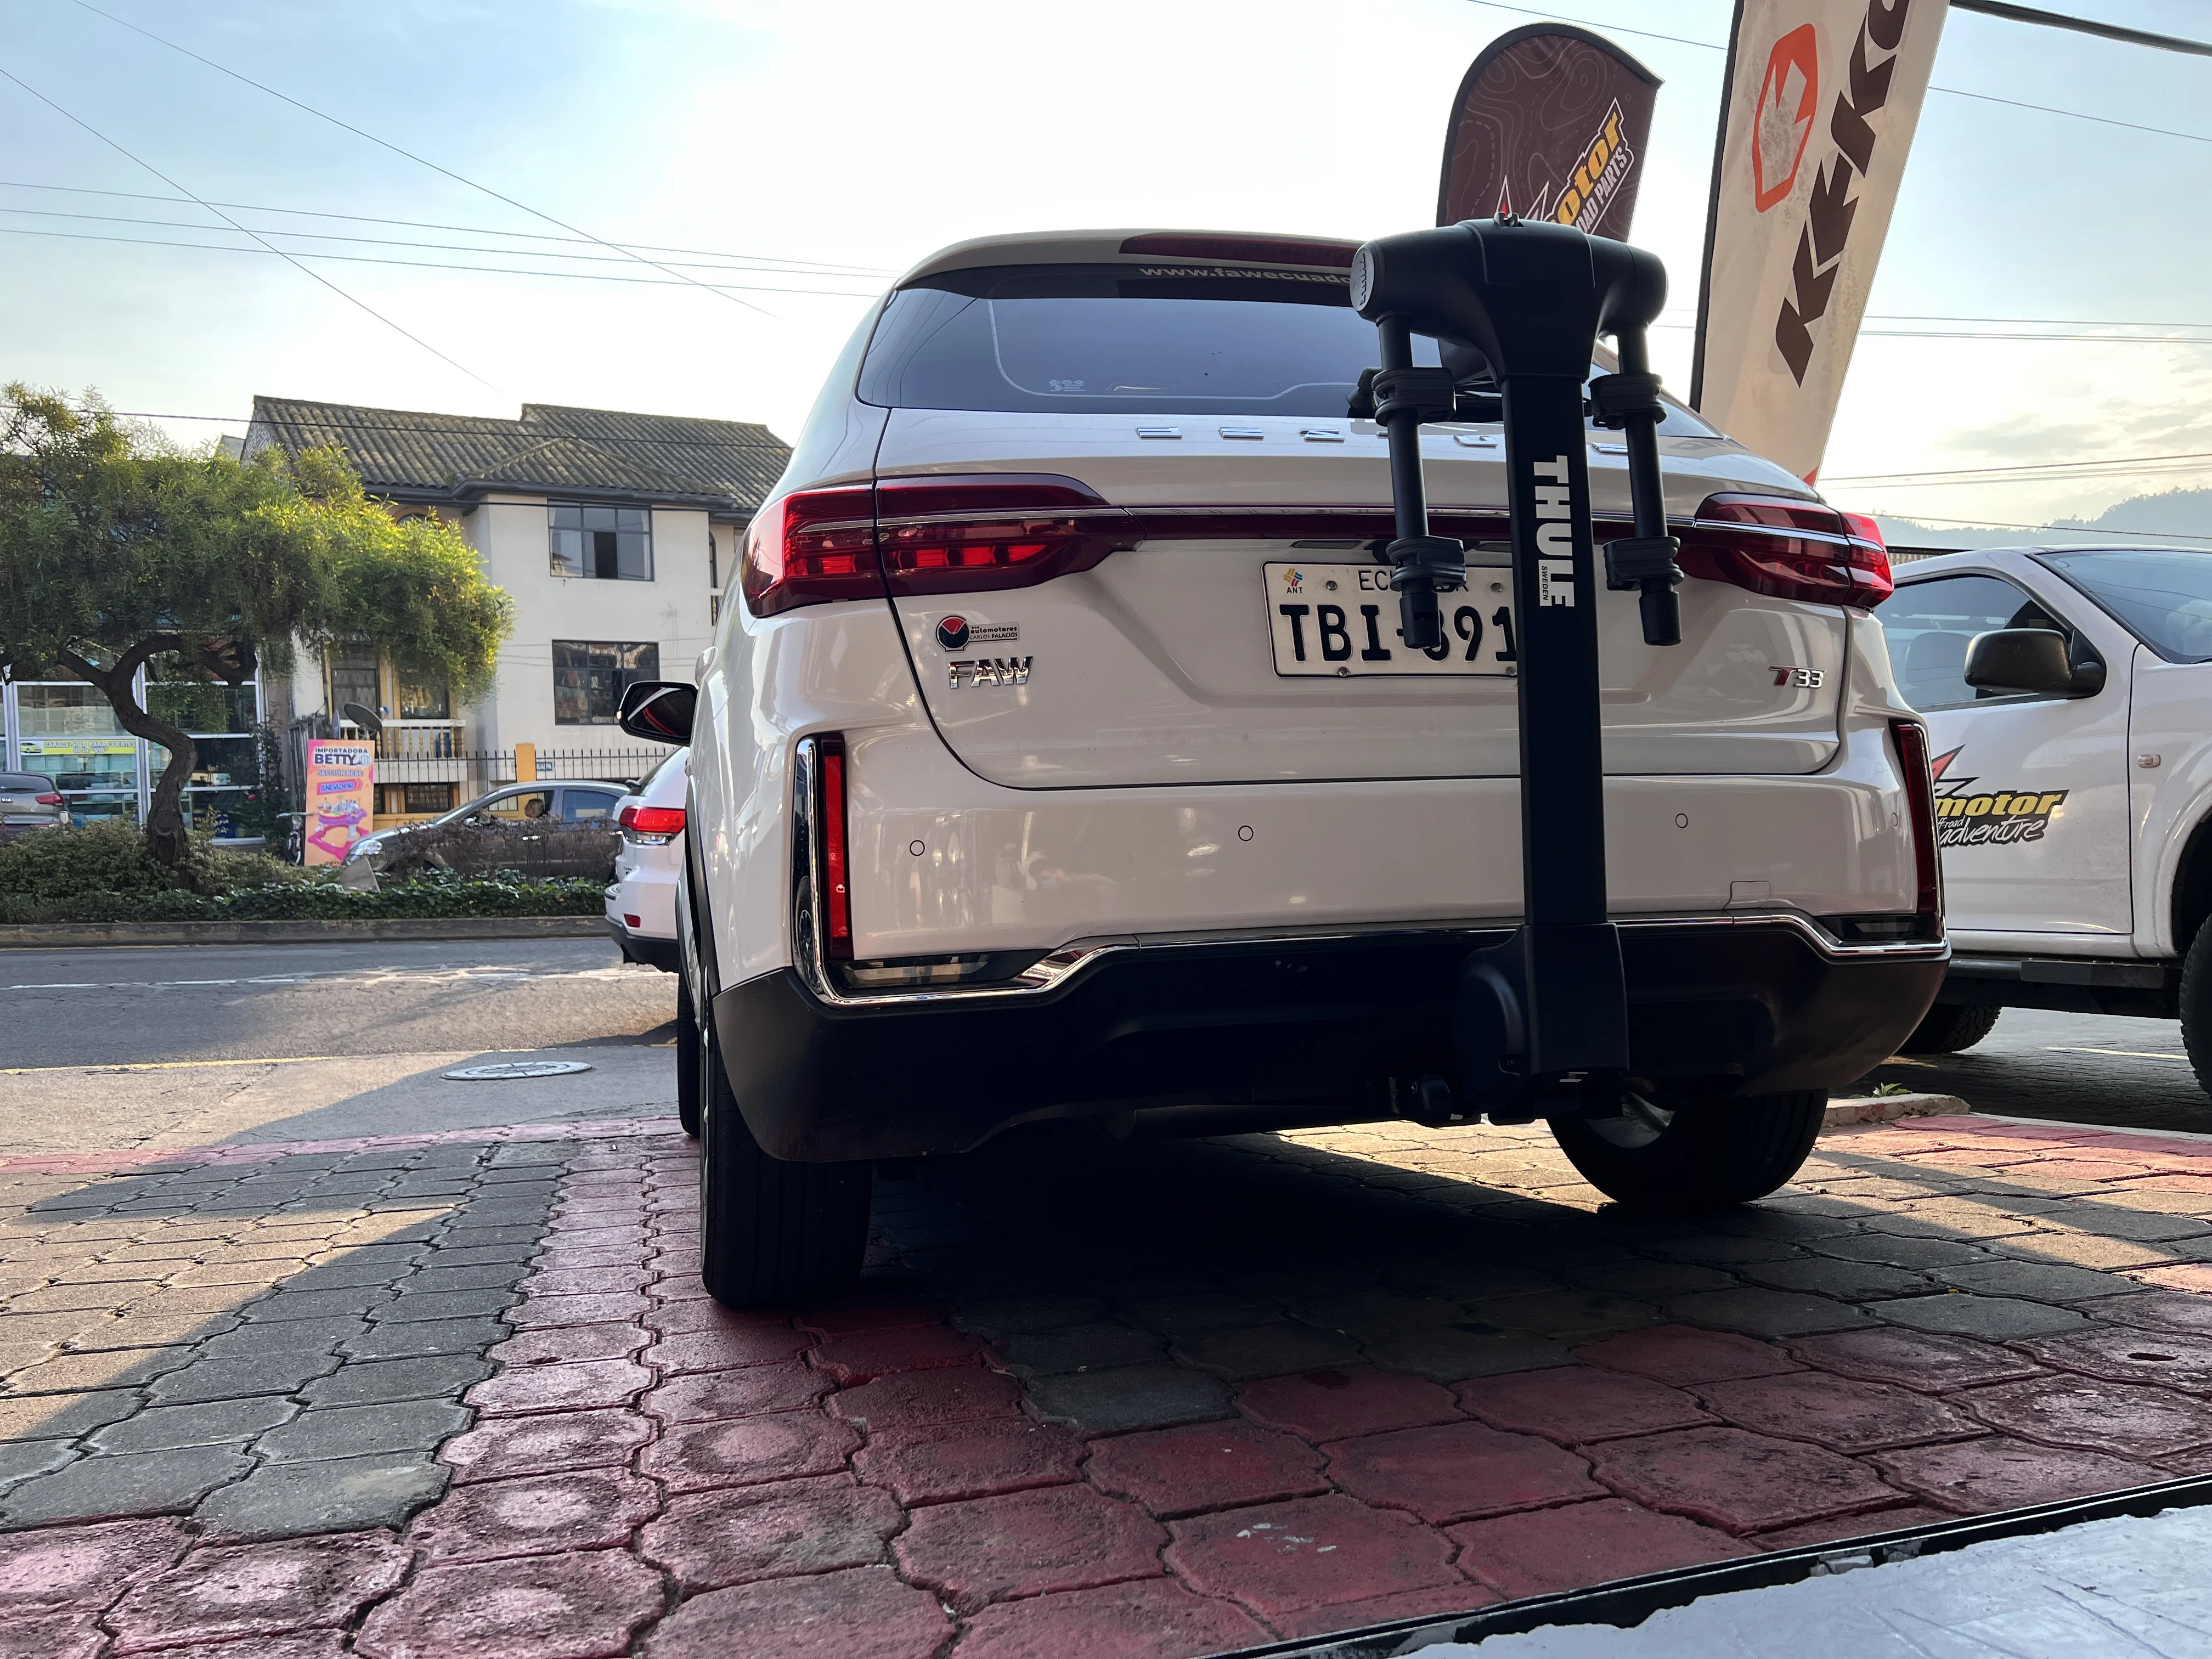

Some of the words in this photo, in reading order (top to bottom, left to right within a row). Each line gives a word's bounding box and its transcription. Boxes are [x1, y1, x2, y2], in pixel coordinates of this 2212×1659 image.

[1550, 111, 1619, 225] otor
[1594, 146, 1627, 207] PARTS
[1533, 455, 1575, 607] THULE
[948, 656, 1033, 689] FAW
[314, 754, 356, 765] BETTY
[321, 781, 354, 792] ANDADOR
[1935, 794, 2063, 816] motor
[1939, 815, 2045, 844] adventure
